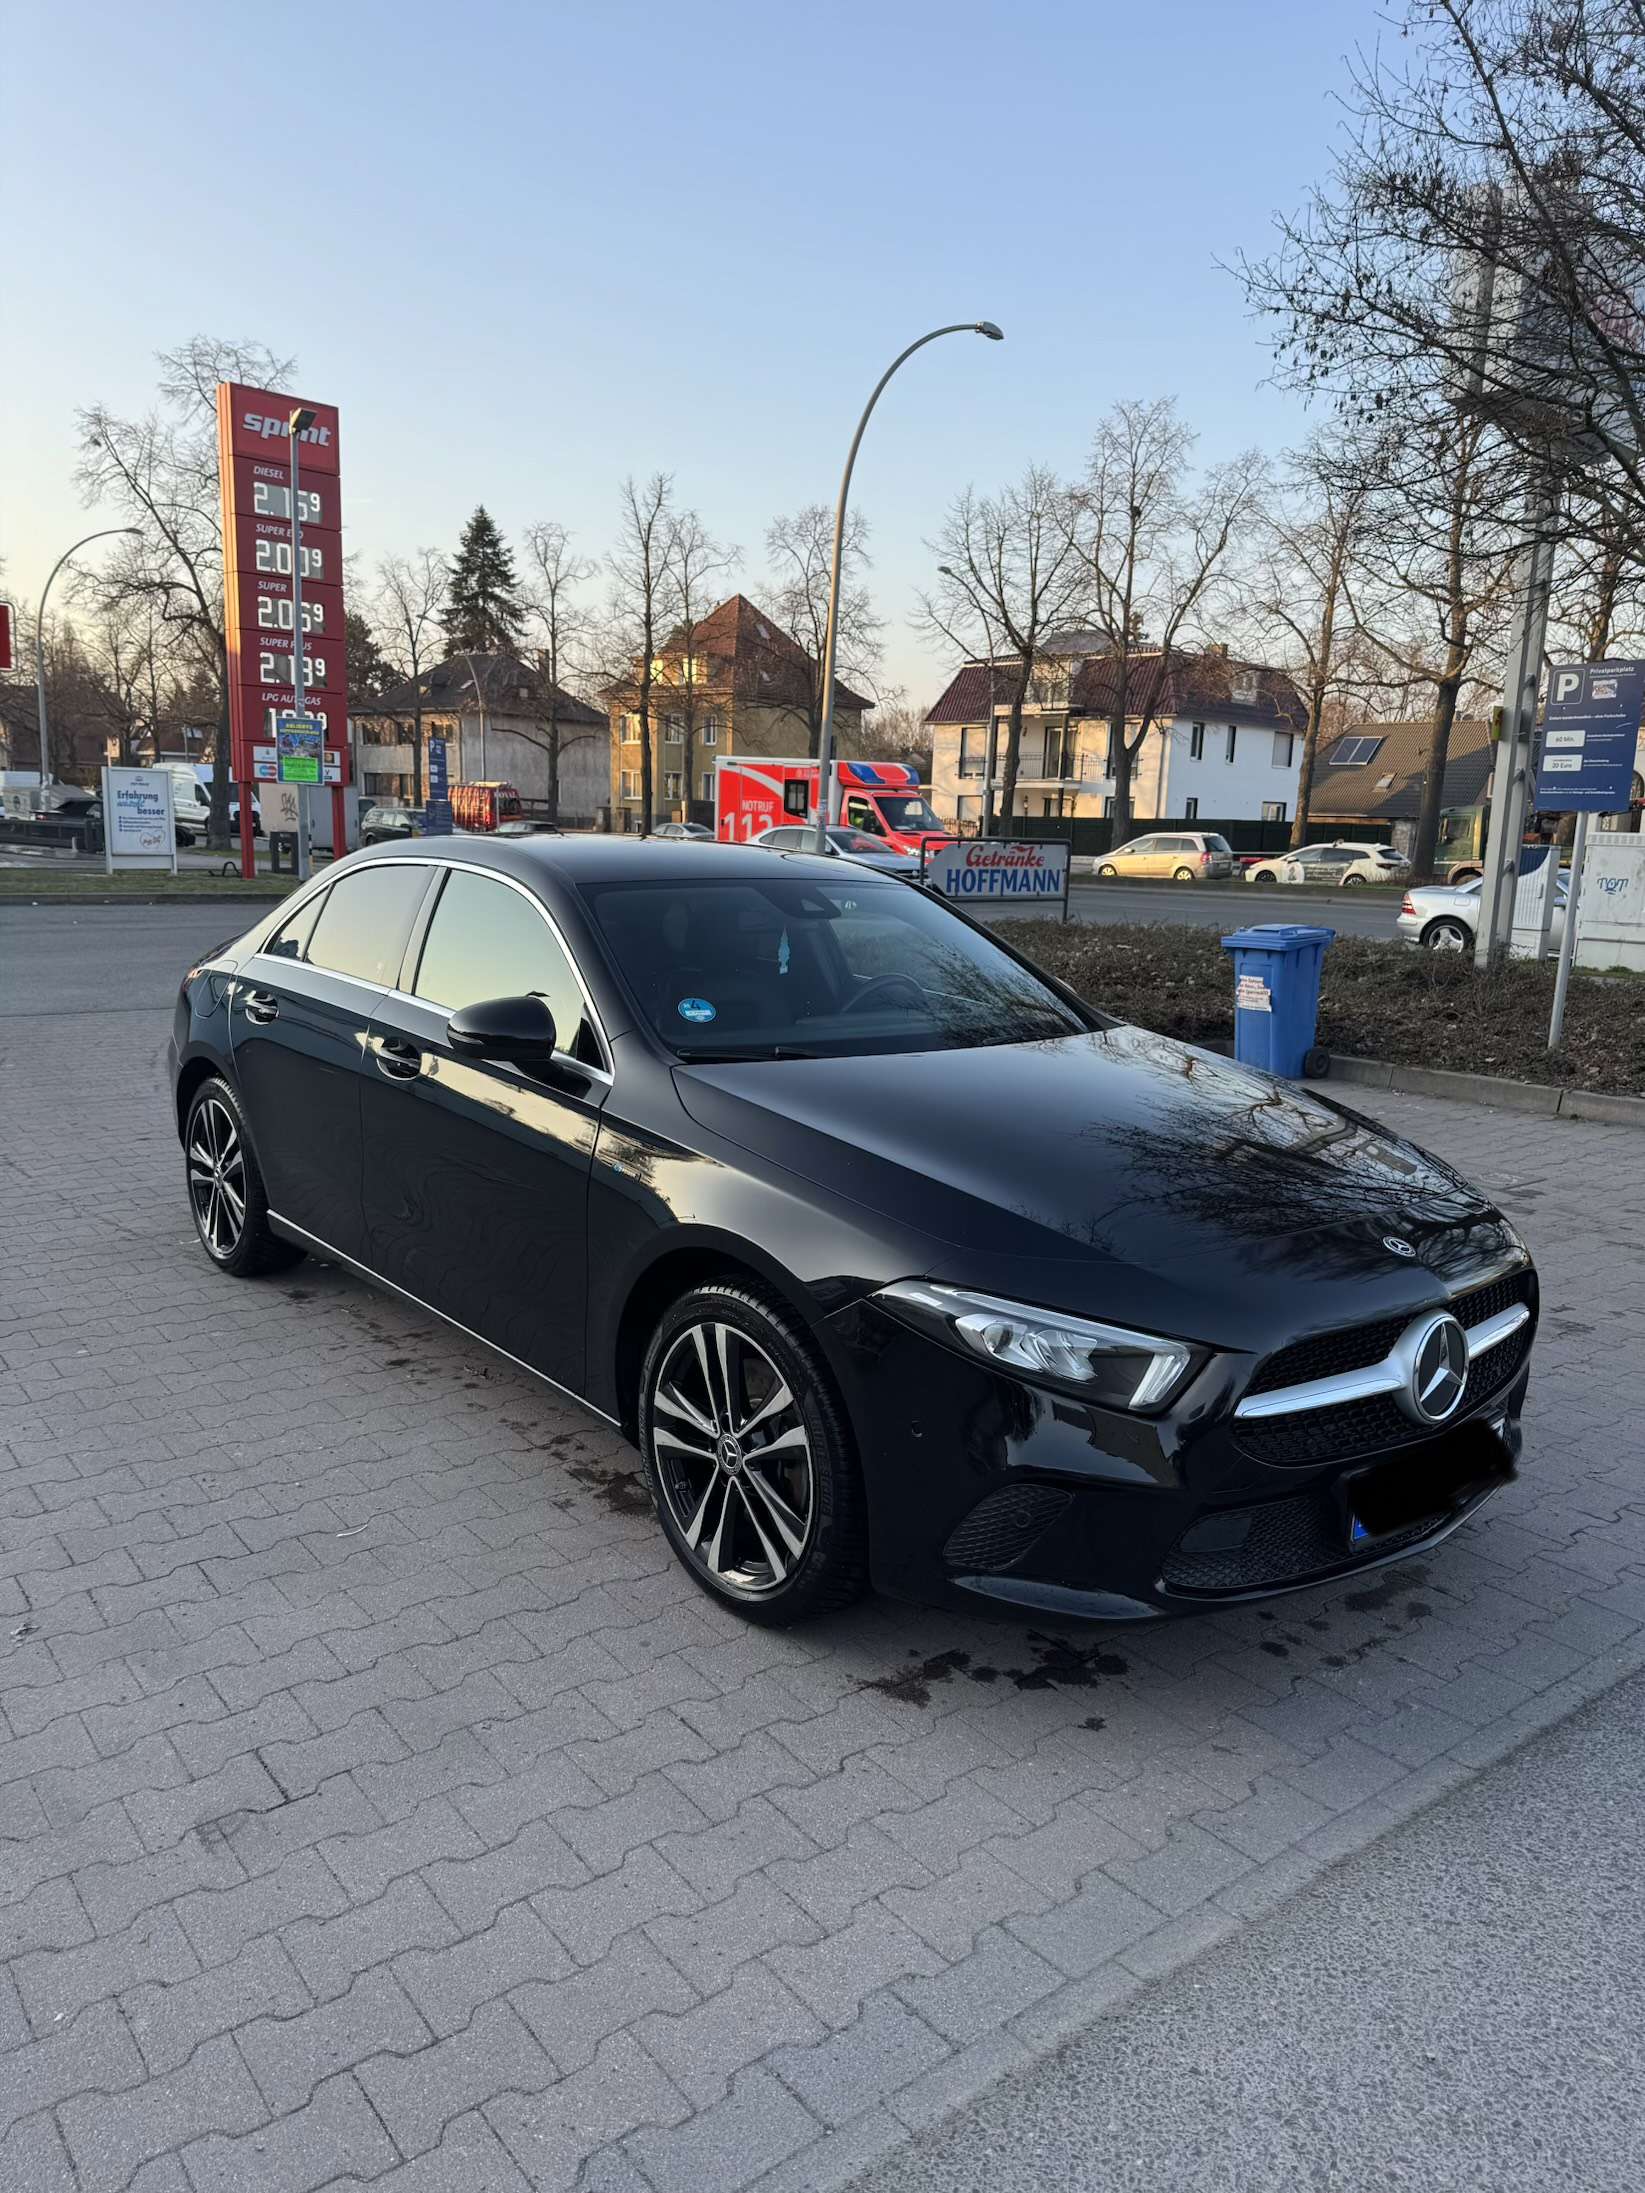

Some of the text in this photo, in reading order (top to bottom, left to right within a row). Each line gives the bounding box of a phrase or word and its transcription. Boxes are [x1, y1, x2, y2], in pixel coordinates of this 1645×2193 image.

[242, 412, 331, 447] sprnt
[253, 465, 285, 480] DIESEL
[256, 523, 285, 537] SUPER
[257, 580, 287, 593] SUPER
[259, 636, 312, 651] SUPER PUS
[1556, 673, 1580, 701] P
[261, 692, 279, 702] LPG
[117, 790, 159, 802] Erfahrung
[137, 807, 164, 815] besser
[741, 800, 775, 813] NOTRUF
[965, 845, 1046, 868] Getränke
[946, 868, 1061, 894] HOFFMANN
